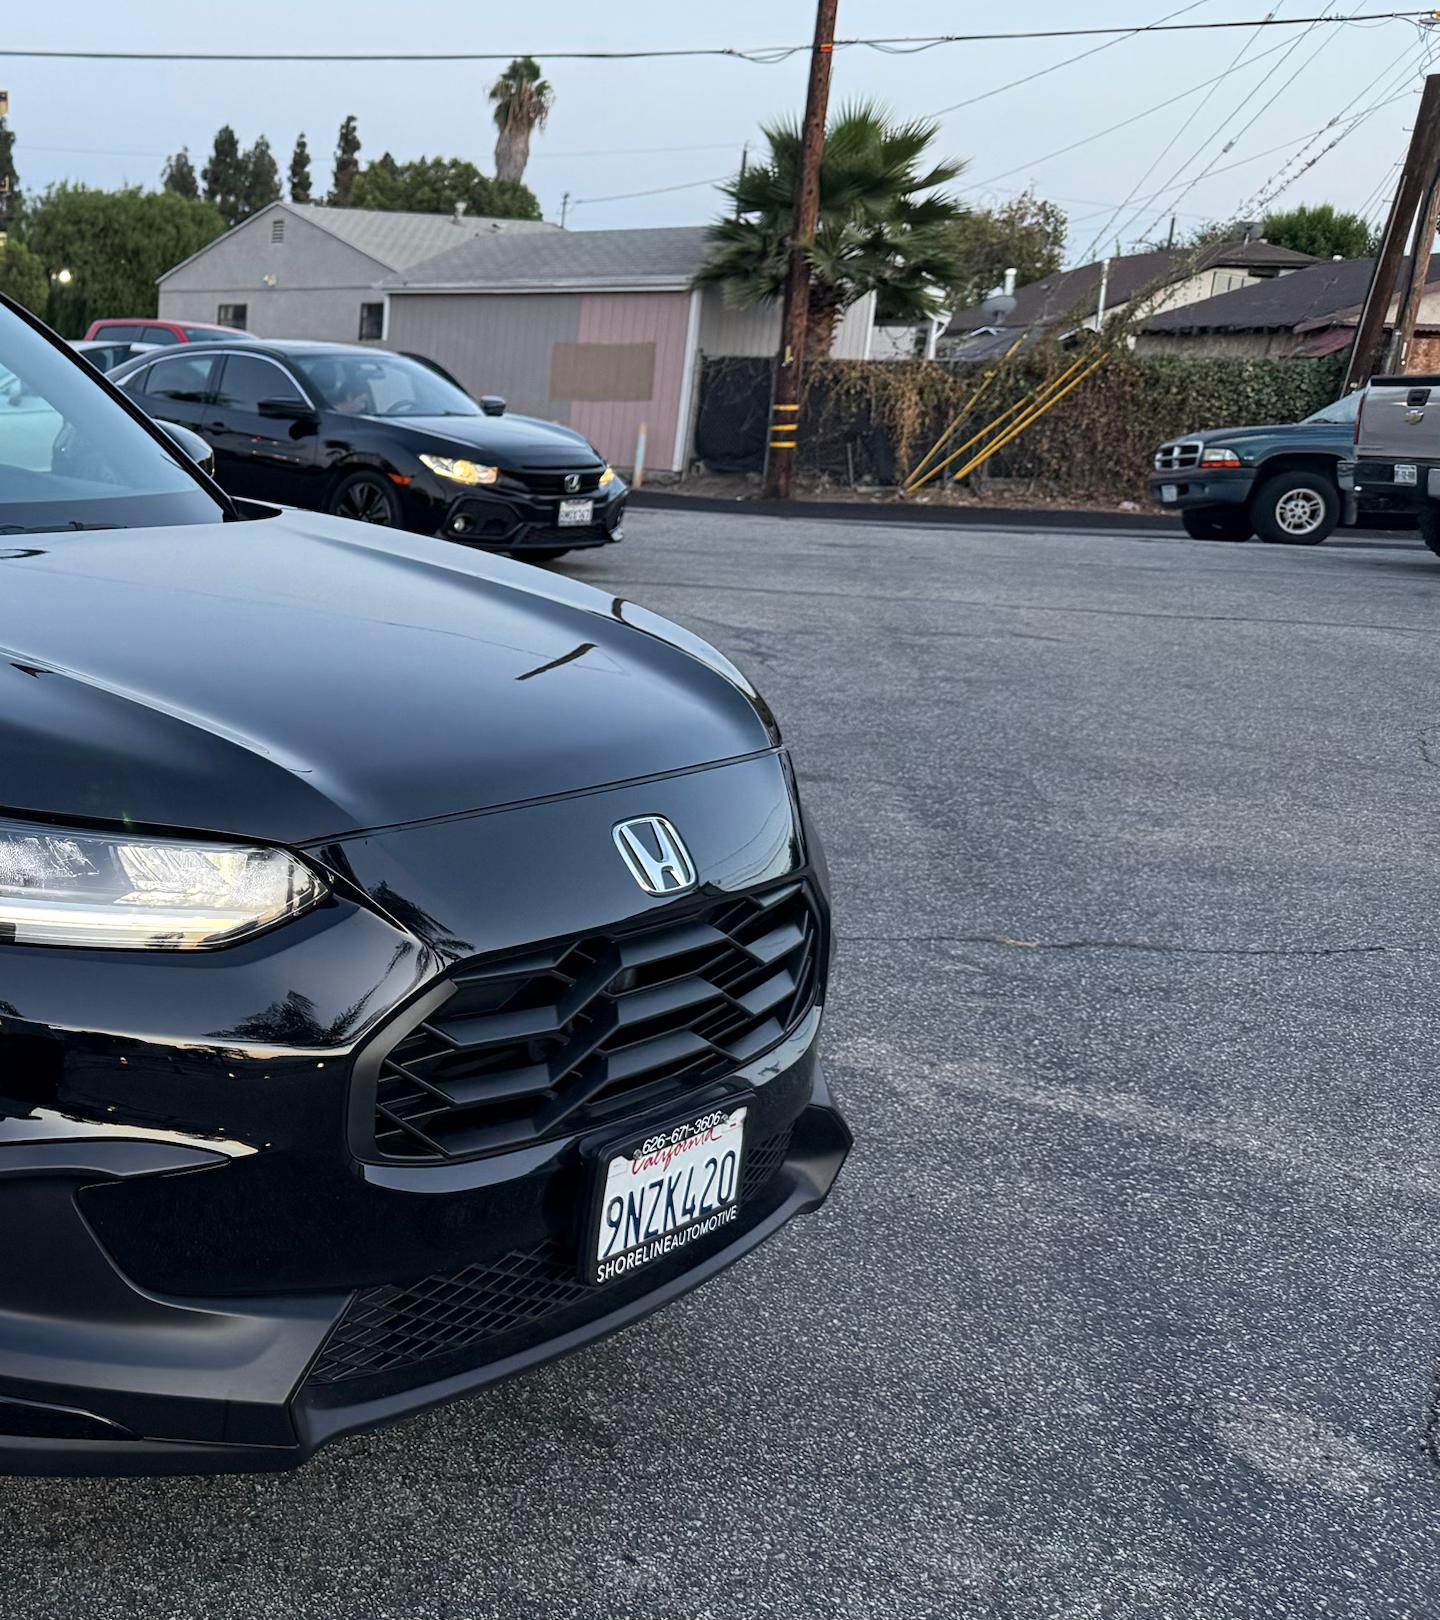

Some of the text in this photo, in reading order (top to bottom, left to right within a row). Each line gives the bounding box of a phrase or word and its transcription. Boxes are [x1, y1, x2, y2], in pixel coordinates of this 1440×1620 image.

[631, 1128, 722, 1176] California
[642, 1111, 722, 1155] 626-671-3606
[603, 1150, 736, 1258] 9NZK420
[597, 1204, 738, 1283] SHORELINEAUTOMOTIVE
